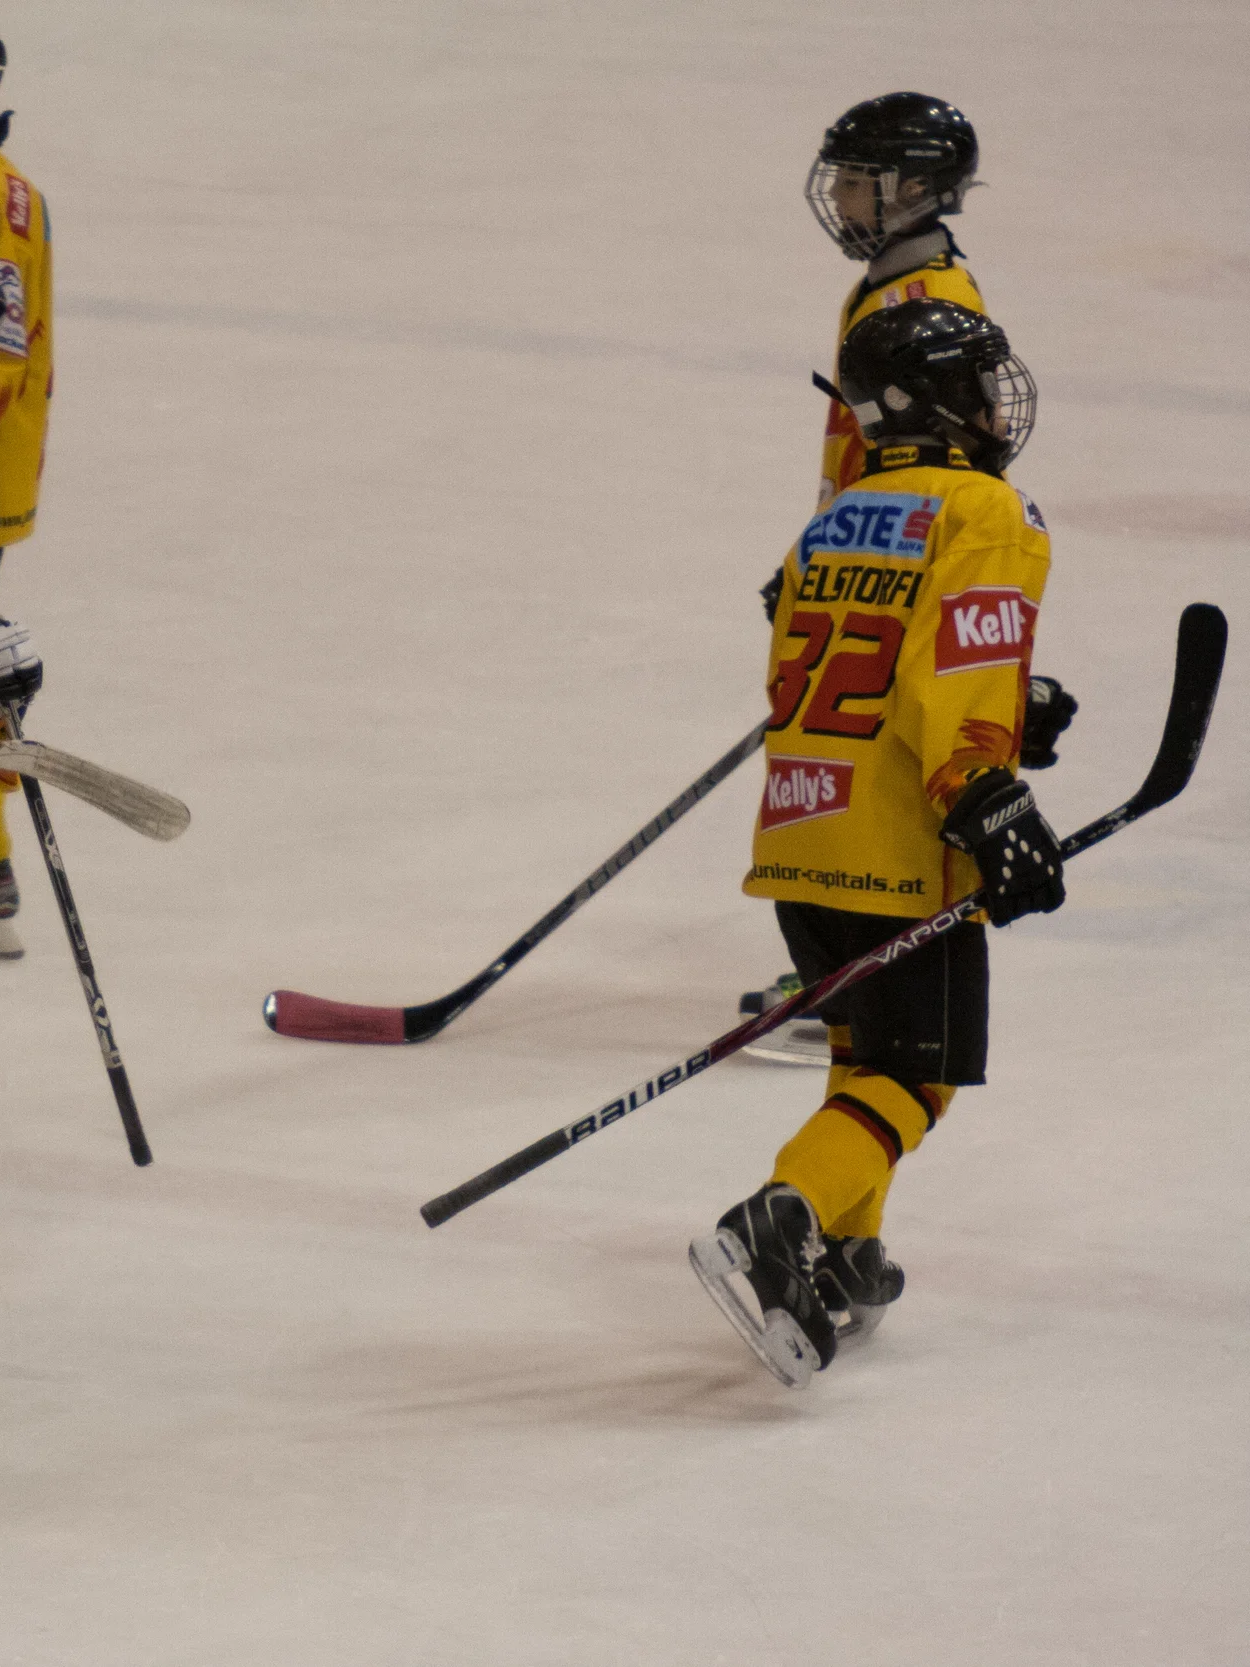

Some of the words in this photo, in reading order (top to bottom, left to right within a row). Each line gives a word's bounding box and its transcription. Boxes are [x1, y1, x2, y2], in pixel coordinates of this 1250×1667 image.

[953, 599, 1025, 648] Kell
[763, 610, 906, 741] 32
[768, 767, 837, 812] Kelly's
[870, 897, 982, 963] VAPOR
